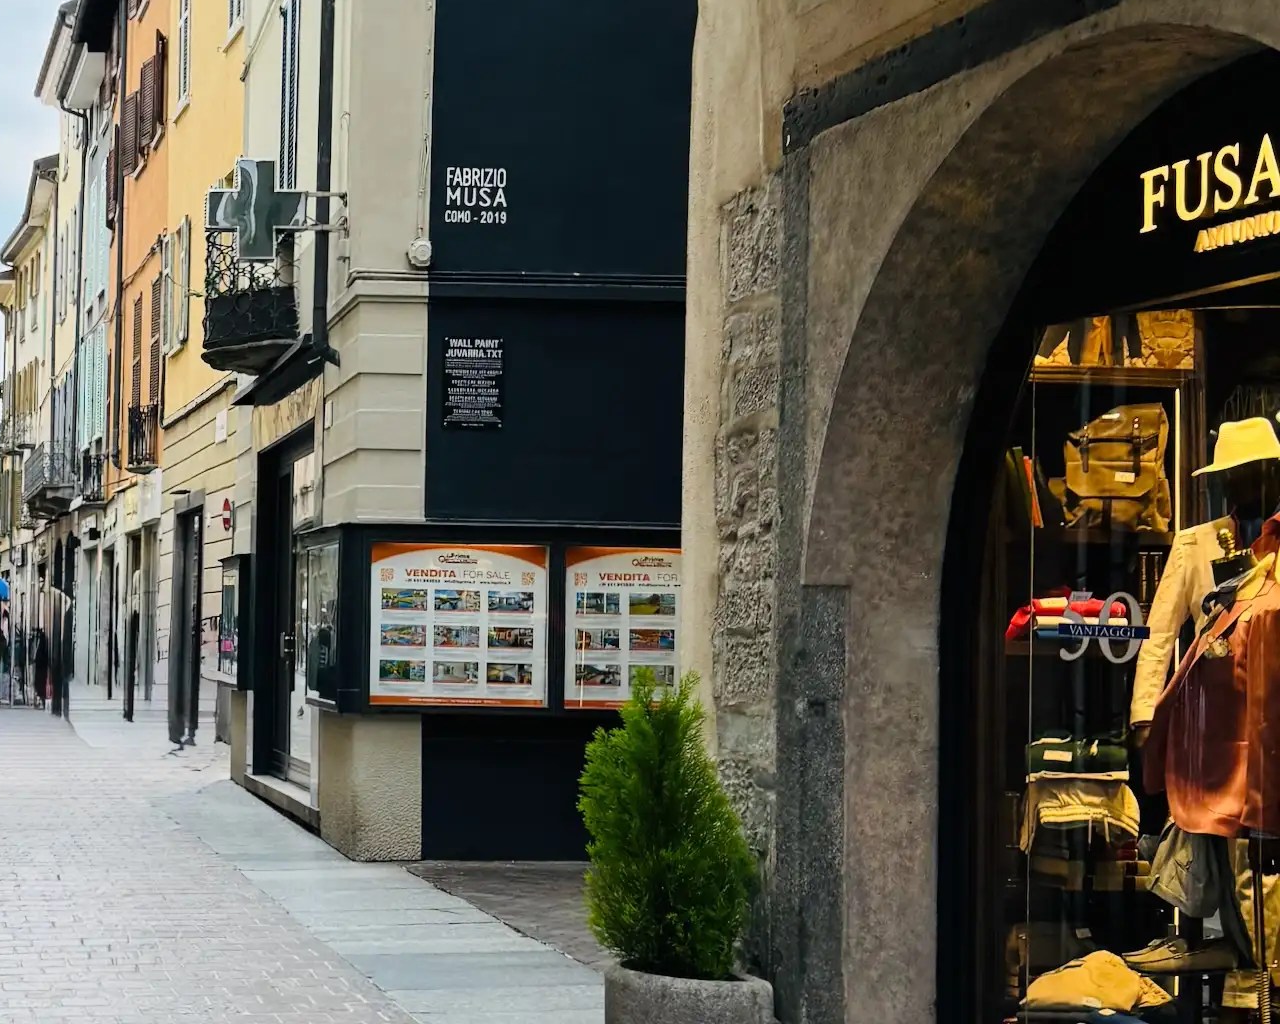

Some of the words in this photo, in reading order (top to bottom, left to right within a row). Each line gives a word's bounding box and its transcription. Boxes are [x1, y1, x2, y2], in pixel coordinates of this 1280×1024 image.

[446, 167, 507, 188] FABRIZIO
[446, 188, 507, 207] MUSA
[445, 210, 471, 224] COMO
[480, 211, 507, 225] 2019
[449, 339, 473, 348] WALL
[475, 339, 499, 349] PAINT
[405, 568, 456, 578] VENDITA
[463, 570, 483, 579] FOR
[486, 571, 511, 580] SALE
[599, 572, 651, 581] VENDITA
[657, 573, 678, 582] FOR
[1069, 624, 1136, 638] VANTAGGI
